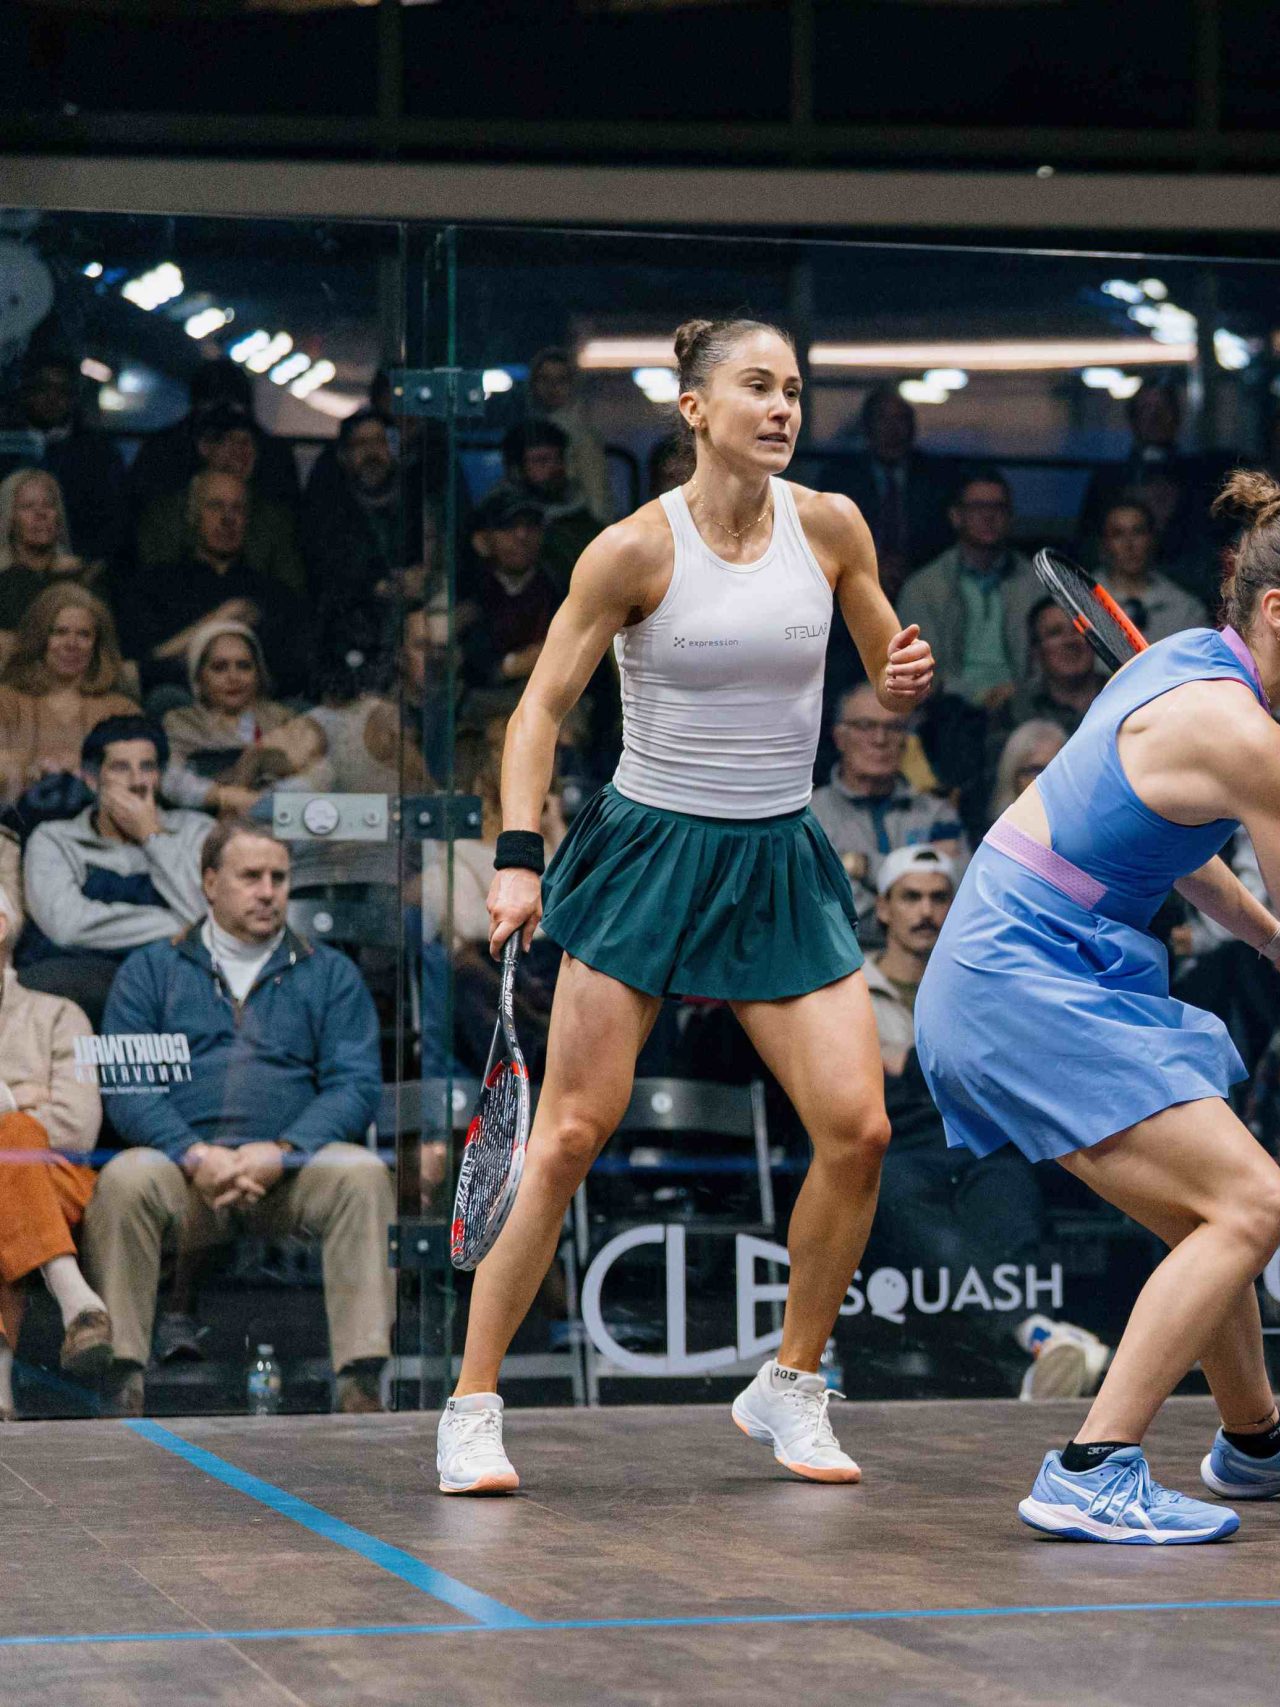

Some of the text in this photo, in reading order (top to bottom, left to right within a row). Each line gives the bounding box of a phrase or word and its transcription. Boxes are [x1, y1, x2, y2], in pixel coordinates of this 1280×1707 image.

[688, 637, 739, 648] expression
[839, 1262, 1063, 1324] SQUASH
[774, 1367, 798, 1381] 305
